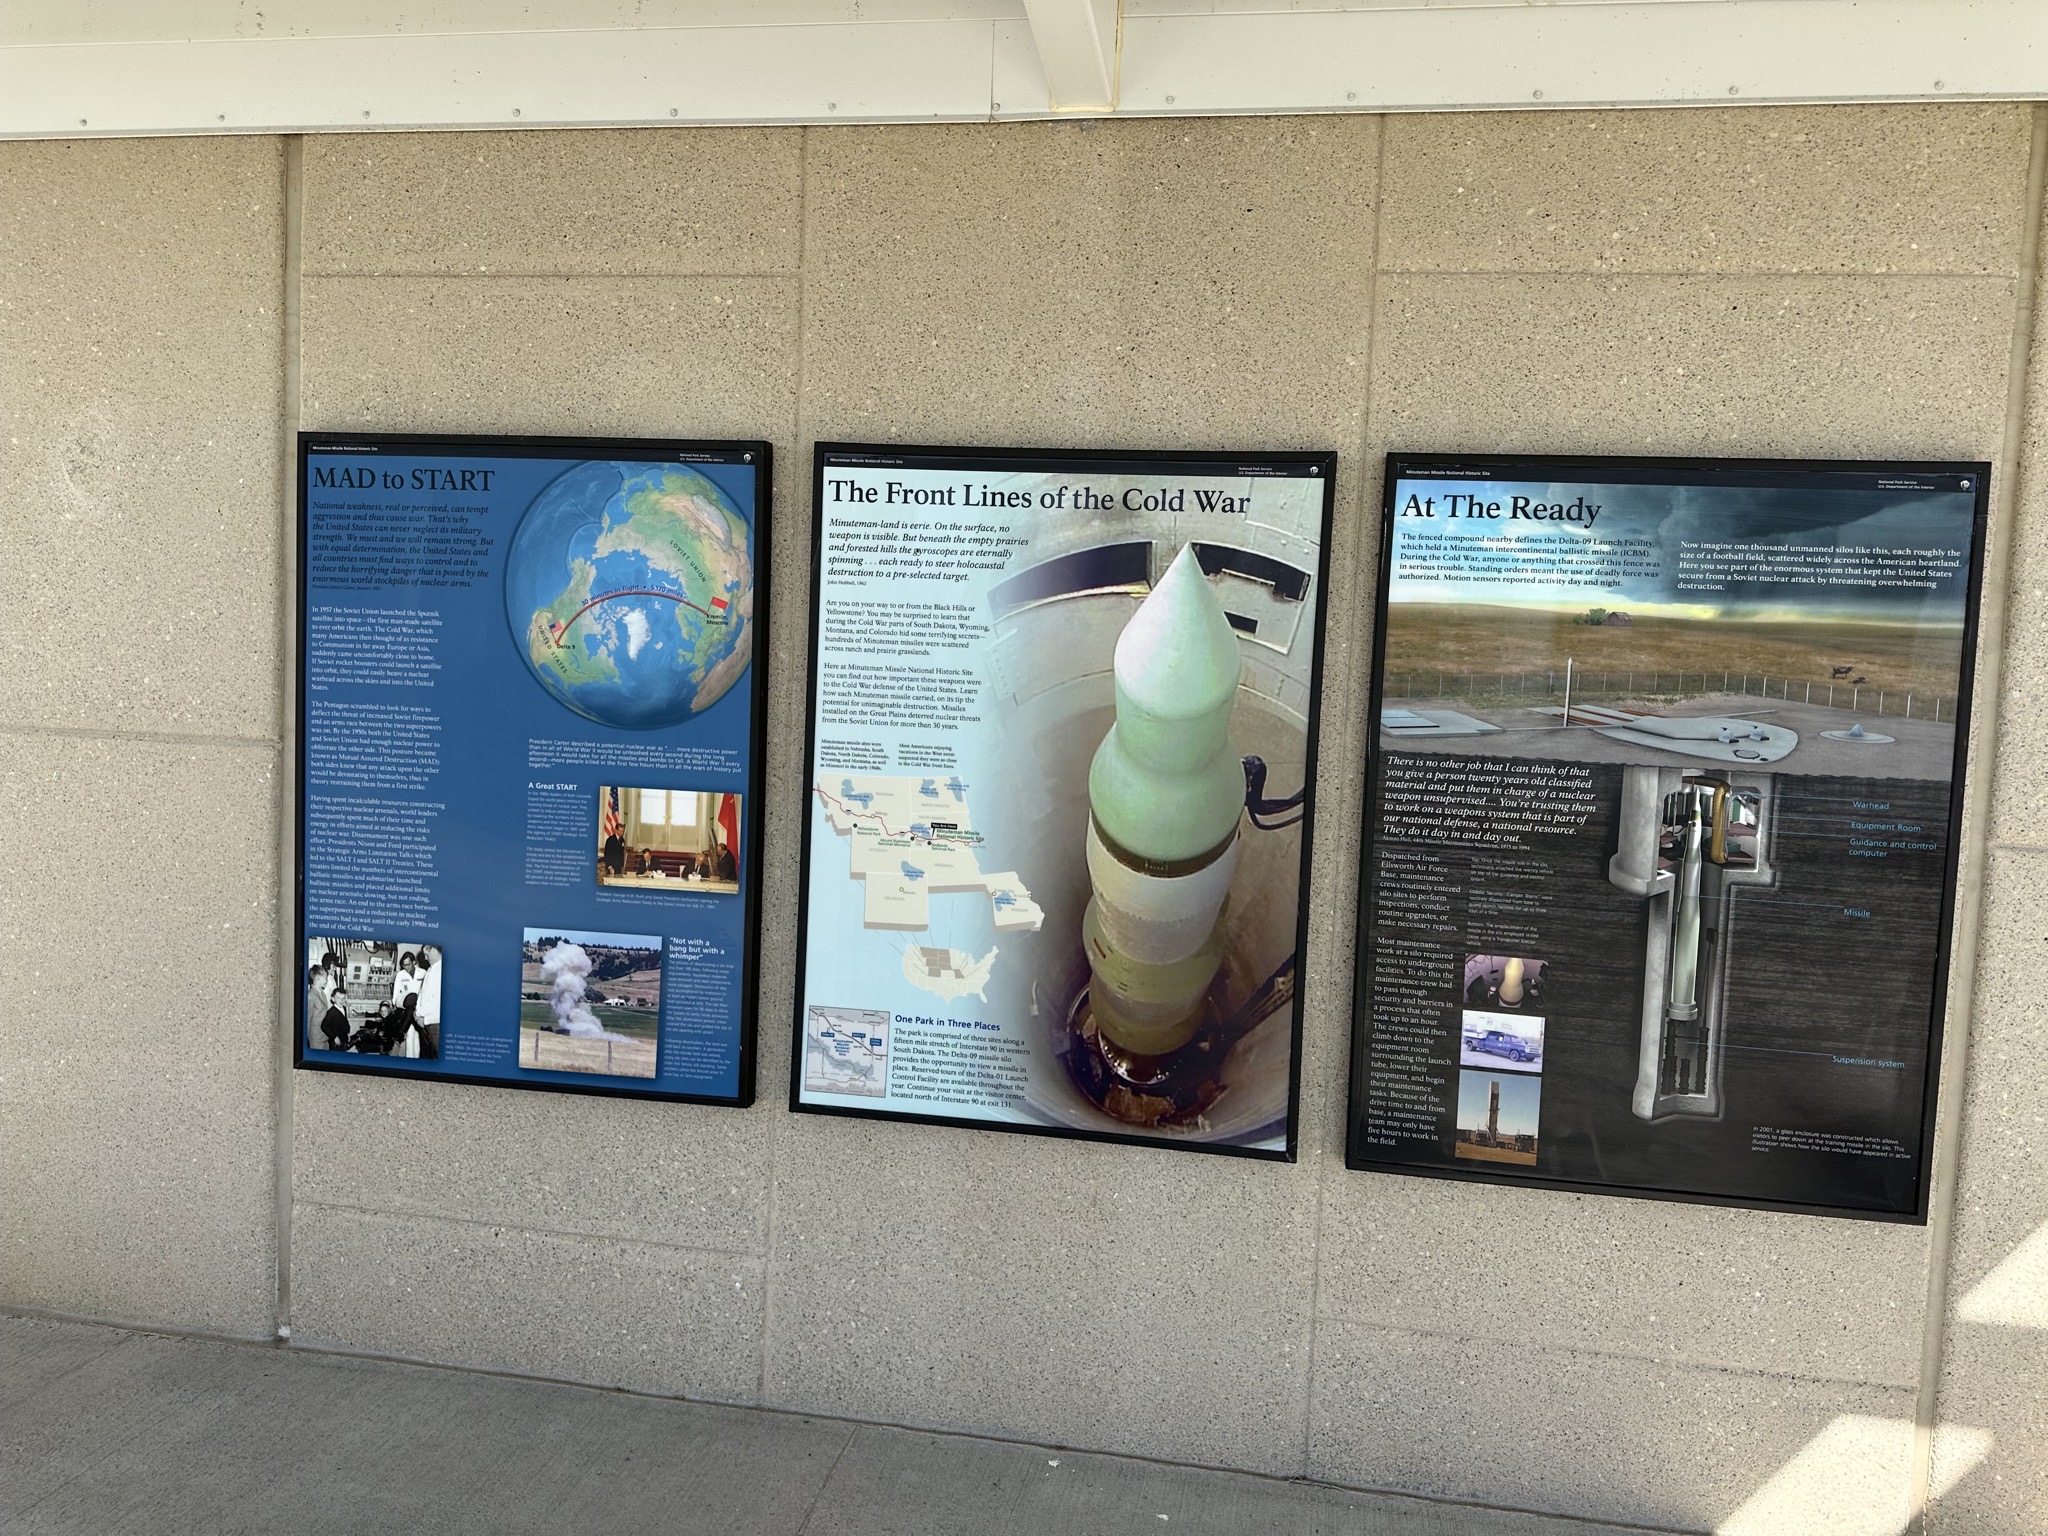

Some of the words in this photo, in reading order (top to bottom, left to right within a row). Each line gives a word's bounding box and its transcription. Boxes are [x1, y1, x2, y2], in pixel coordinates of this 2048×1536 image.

[313, 468, 375, 489] MAD
[382, 469, 404, 489] to
[411, 470, 495, 491] START
[828, 480, 877, 504] The
[885, 481, 955, 506] Front
[962, 483, 1031, 508] Lines
[1040, 485, 1068, 509] of
[1072, 486, 1113, 510] the
[1122, 487, 1184, 511] Cold
[1193, 488, 1250, 513] War
[312, 501, 345, 510] National
[346, 502, 383, 512] weakness,
[385, 503, 400, 511] real
[411, 503, 449, 514] perceived,
[466, 505, 488, 515] tempt
[1401, 494, 1435, 518] At
[1443, 495, 1500, 519] The
[1509, 496, 1601, 528] Ready
[312, 512, 350, 523] aggression
[352, 513, 367, 521] and
[368, 513, 384, 522] thus
[453, 515, 469, 526] why
[829, 519, 900, 530] Minuteman-land
[901, 521, 908, 530] is
[909, 521, 931, 530] eerie.
[934, 522, 947, 531] On
[949, 522, 962, 531] the
[964, 522, 996, 534] surface,
[829, 533, 861, 542] weapon
[863, 532, 869, 540] is
[872, 532, 899, 541] visible.
[902, 533, 917, 542] But
[918, 533, 951, 543] beneath
[953, 534, 966, 543] the
[968, 535, 994, 546] empty
[995, 536, 1028, 548] prairies
[1401, 533, 1416, 541] The
[1418, 533, 1442, 541] fenced
[1444, 534, 1484, 545] compound
[1486, 535, 1513, 545] nearby
[1514, 536, 1542, 544] defines
[1558, 537, 1591, 545] Delta-09
[1593, 538, 1622, 546] Launch
[1624, 539, 1655, 549] Facility,
[1681, 540, 1699, 549] Now
[1701, 541, 1732, 552] imagine
[1751, 542, 1788, 551] thousand
[1790, 544, 1833, 553] unmanned
[1835, 545, 1853, 553] silos
[1855, 546, 1870, 554] like
[1872, 546, 1890, 555] this,
[1892, 547, 1911, 555] each
[1913, 547, 1945, 558] roughly
[1947, 548, 1960, 556] the
[669, 540, 690, 560] SOVIET
[690, 561, 707, 582] UNION
[590, 590, 613, 602] minutes
[666, 589, 684, 598] miles
[417, 610, 439, 618] Sputnik
[538, 625, 552, 649] UNITED
[551, 652, 567, 673] STATES
[824, 662, 839, 670] Here
[848, 663, 883, 672] Minuteman
[885, 665, 906, 673] Missile
[908, 666, 934, 674] National
[935, 667, 959, 675] Historic
[962, 668, 973, 676] Site
[1387, 756, 1414, 766] There
[1416, 758, 1423, 767] is
[1439, 759, 1466, 769] other
[1465, 761, 1481, 772] job
[1483, 762, 1503, 771] that
[1505, 763, 1509, 772] I
[1511, 765, 1528, 773] can
[1531, 764, 1556, 774] think
[1558, 766, 1569, 777] of
[1569, 767, 1589, 776] that
[535, 782, 554, 790] Great
[1852, 801, 1889, 809] Warhead
[1851, 821, 1895, 832] Equipment
[1897, 824, 1922, 832] Room
[1383, 825, 1406, 837] They
[1408, 826, 1420, 835] do
[1422, 827, 1429, 836] it
[1430, 828, 1448, 840] day
[1450, 829, 1460, 838] in
[1462, 830, 1481, 840] and
[1483, 831, 1501, 844] day
[1503, 833, 1521, 842] out.
[1850, 838, 1887, 847] Guidance
[1889, 840, 1905, 848] and
[1907, 841, 1937, 849] control
[1381, 851, 1420, 863] Dispatched
[1422, 854, 1439, 862] from
[1849, 849, 1887, 858] computer
[1381, 861, 1414, 870] Ellsworth
[1415, 863, 1426, 871] Air
[1428, 864, 1448, 872] Force
[1844, 908, 1870, 917] Missile
[669, 944, 686, 953] bang
[1377, 937, 1394, 945] Most
[1396, 938, 1440, 948] maintenance
[895, 1015, 912, 1024] One
[915, 1016, 933, 1025] Park
[936, 1018, 944, 1026] in
[947, 1019, 971, 1028] Three
[974, 1021, 1000, 1030] Places
[894, 1027, 906, 1035] The
[907, 1029, 921, 1039] park
[929, 1031, 961, 1040] comprised
[962, 1033, 970, 1041] of
[970, 1034, 986, 1042] three
[988, 1035, 1001, 1043] sites
[1002, 1037, 1019, 1046] along
[1832, 1055, 1875, 1066] Suspension
[1878, 1060, 1905, 1068] system
